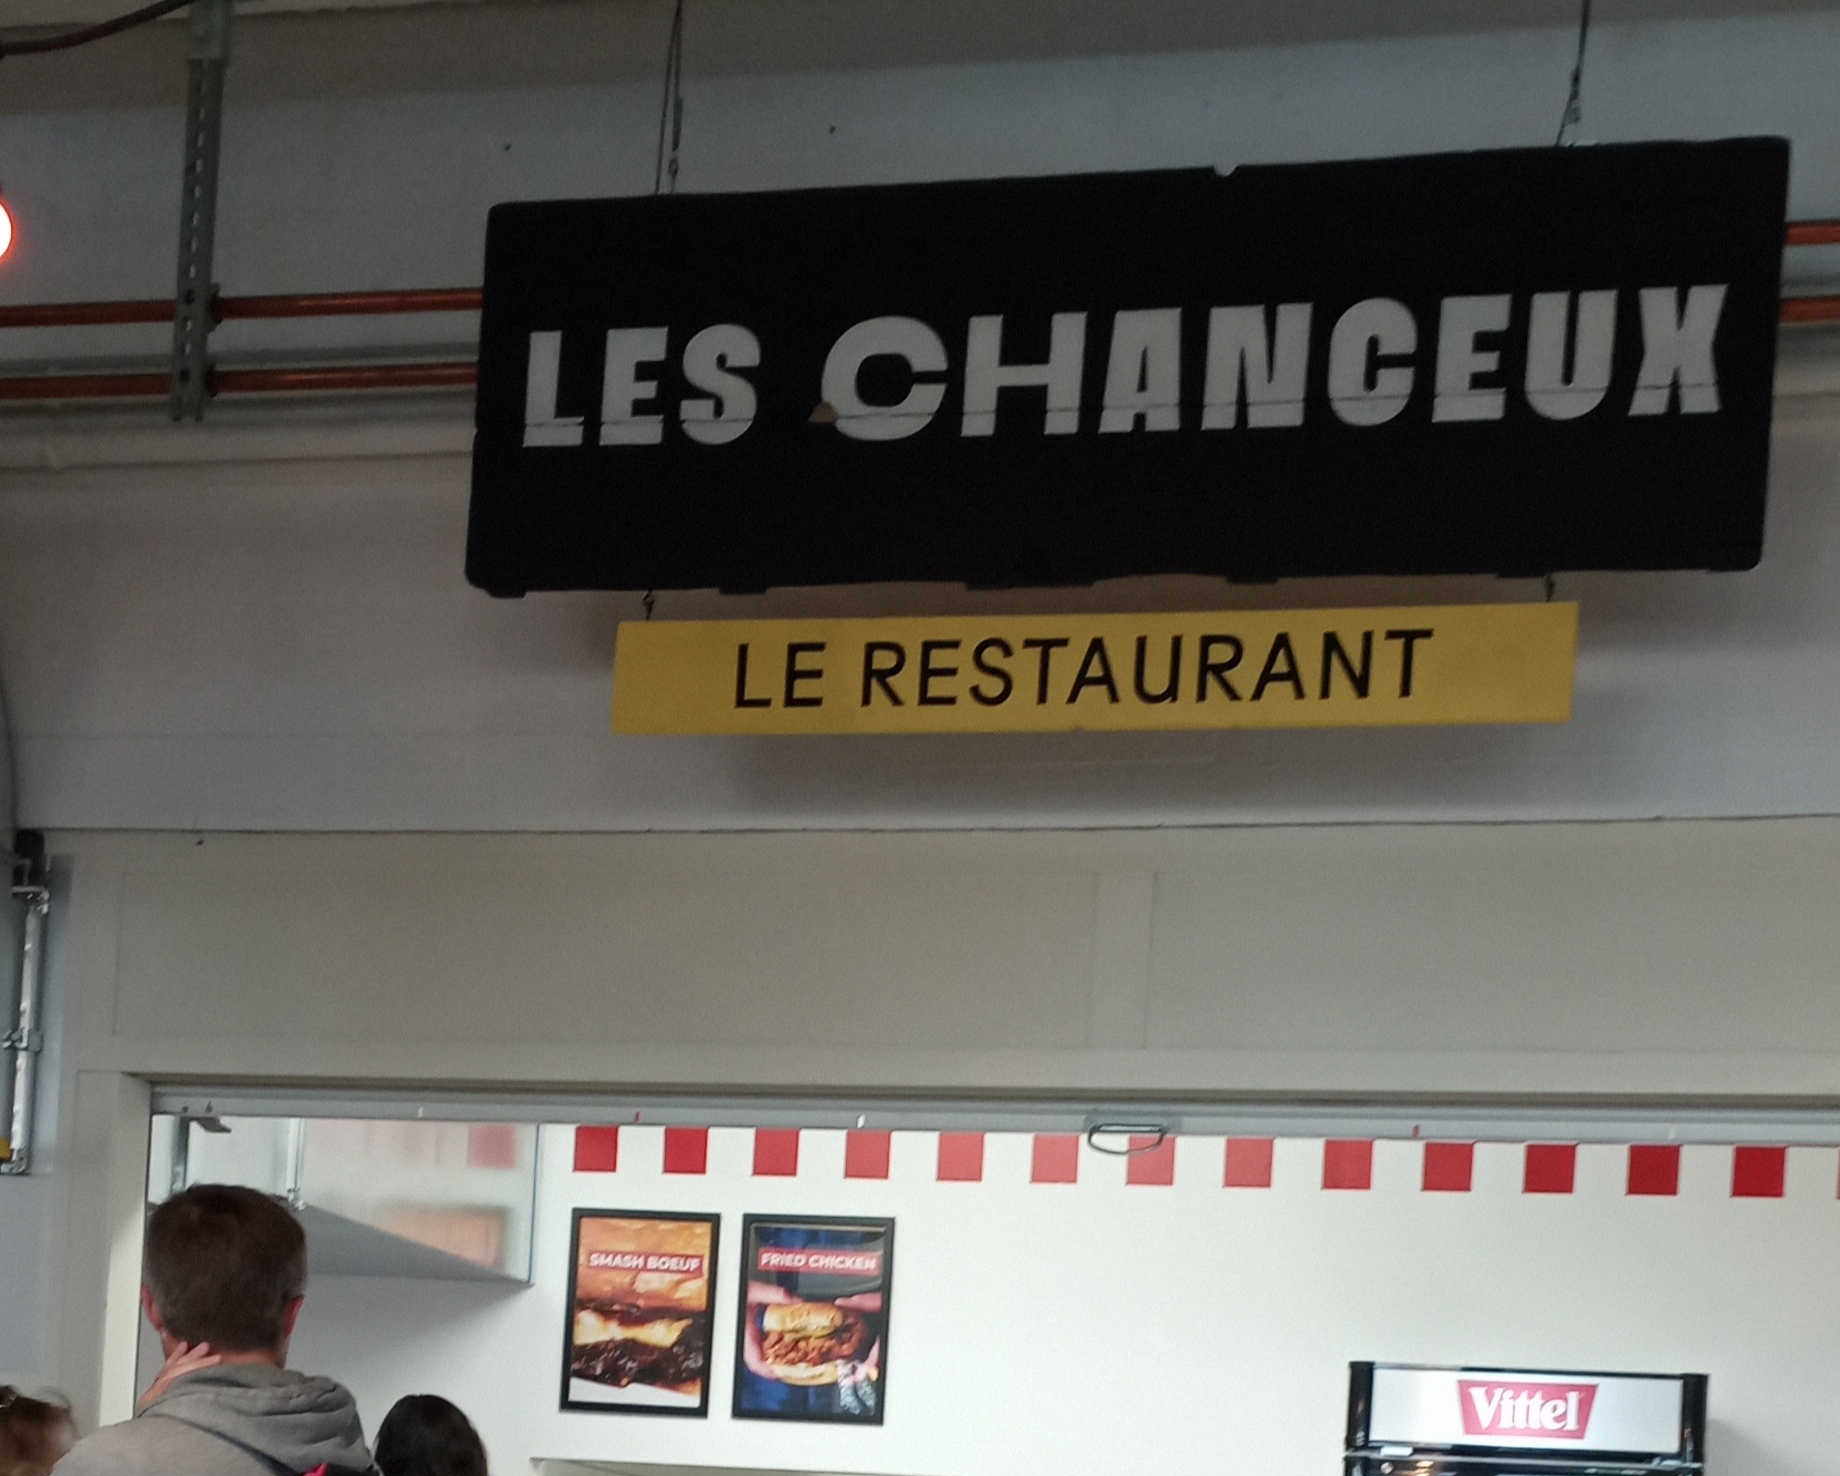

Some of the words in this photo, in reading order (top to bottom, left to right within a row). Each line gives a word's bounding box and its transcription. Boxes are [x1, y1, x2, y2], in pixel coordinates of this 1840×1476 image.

[522, 323, 762, 449] LES
[818, 282, 1730, 444] CHANCEUX
[733, 641, 826, 711] LE
[858, 628, 1436, 708] RESTAURANT
[589, 1252, 645, 1269] SMASH
[646, 1255, 701, 1272] BOEUF
[760, 1251, 807, 1268] FRIED
[808, 1254, 877, 1271] CHICKEN
[1467, 1386, 1580, 1432] Vittel
